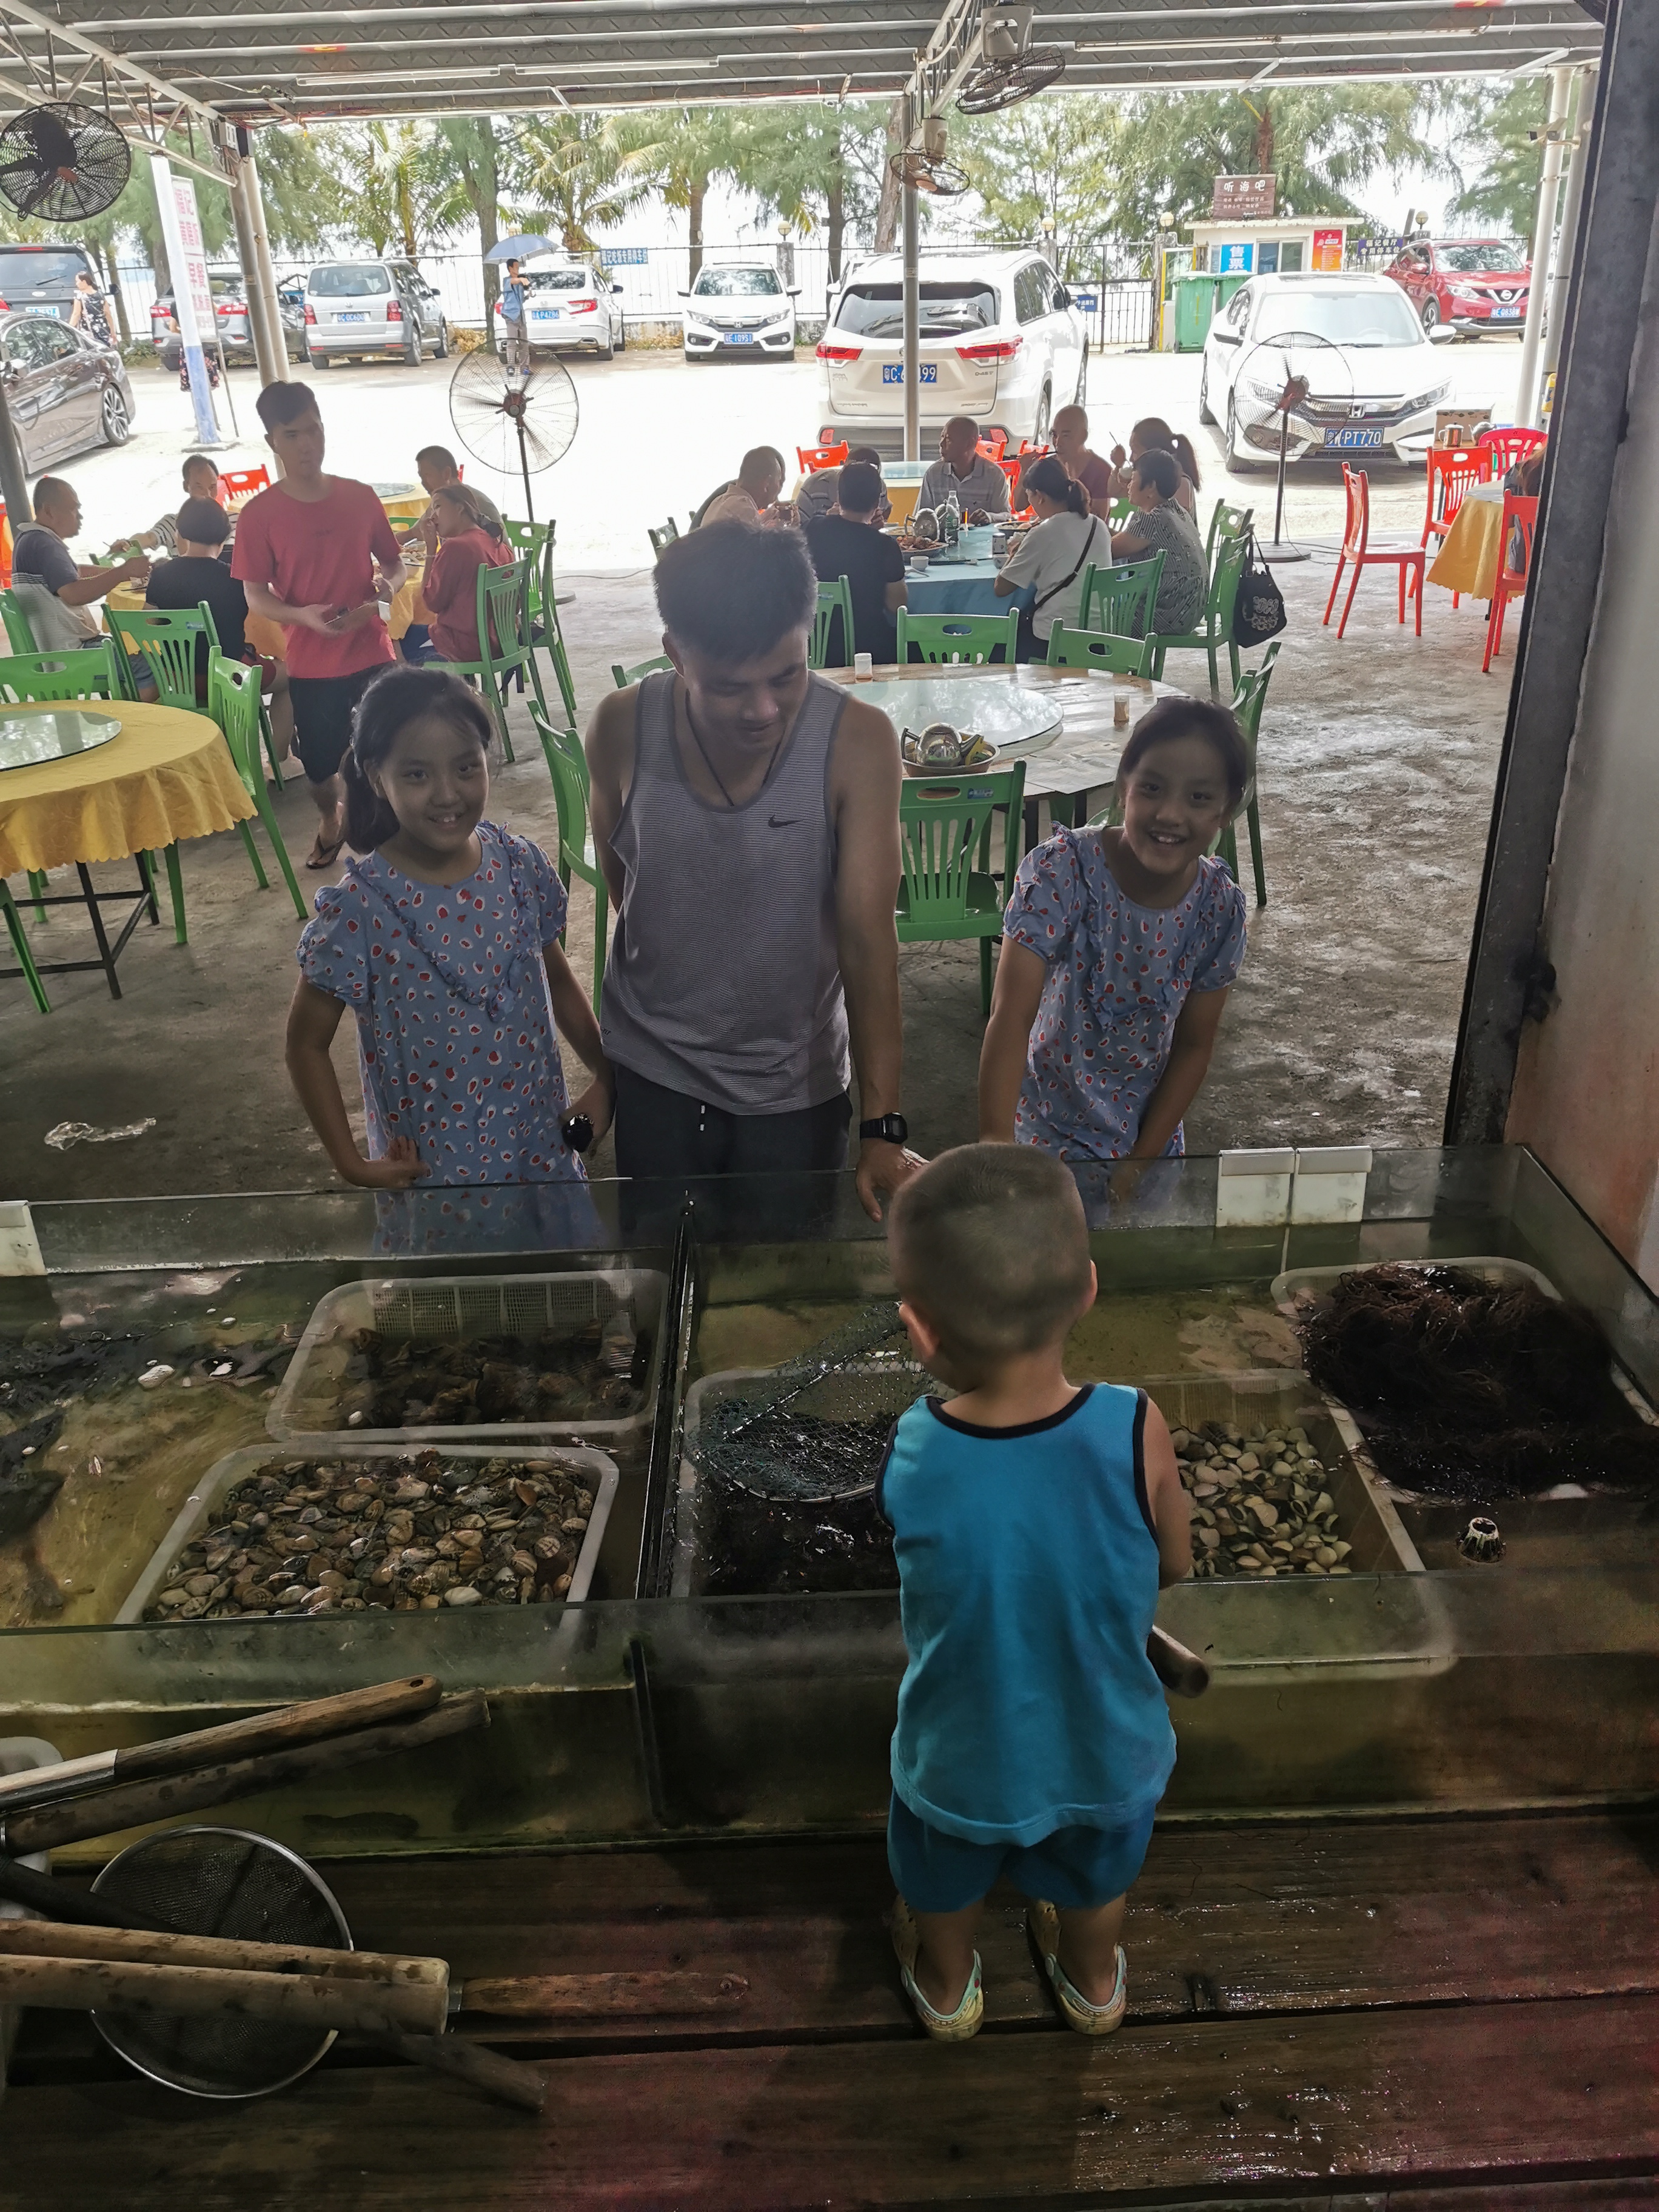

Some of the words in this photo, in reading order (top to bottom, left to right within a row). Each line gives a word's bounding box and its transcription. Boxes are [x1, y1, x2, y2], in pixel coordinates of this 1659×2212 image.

[1224, 179, 1265, 192] 听海吧
[1360, 246, 1400, 255] 专用停车位
[1228, 245, 1245, 270] 售票
